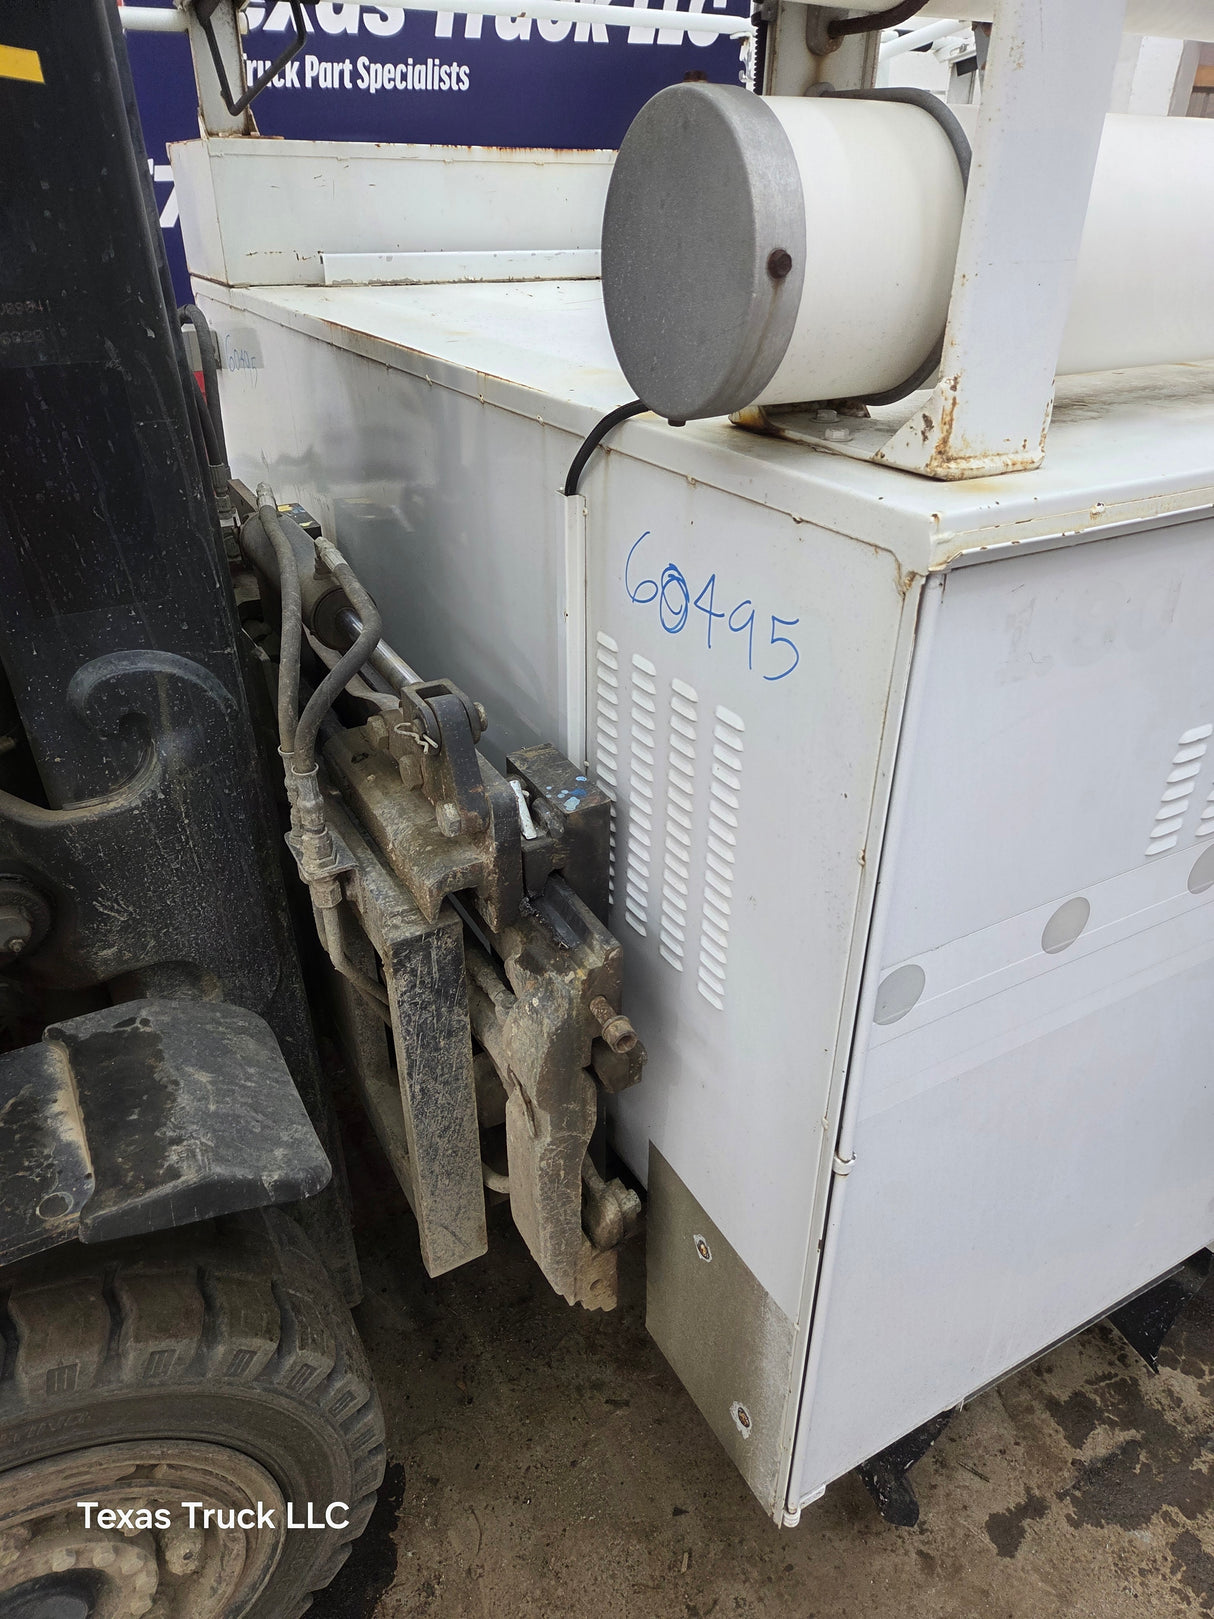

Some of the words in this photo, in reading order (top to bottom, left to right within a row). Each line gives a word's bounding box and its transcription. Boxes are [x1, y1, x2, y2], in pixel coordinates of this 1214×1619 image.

[243, 53, 300, 88] ruck
[305, 55, 352, 89] Part
[356, 56, 470, 93] Specialists
[625, 531, 800, 681] 60495
